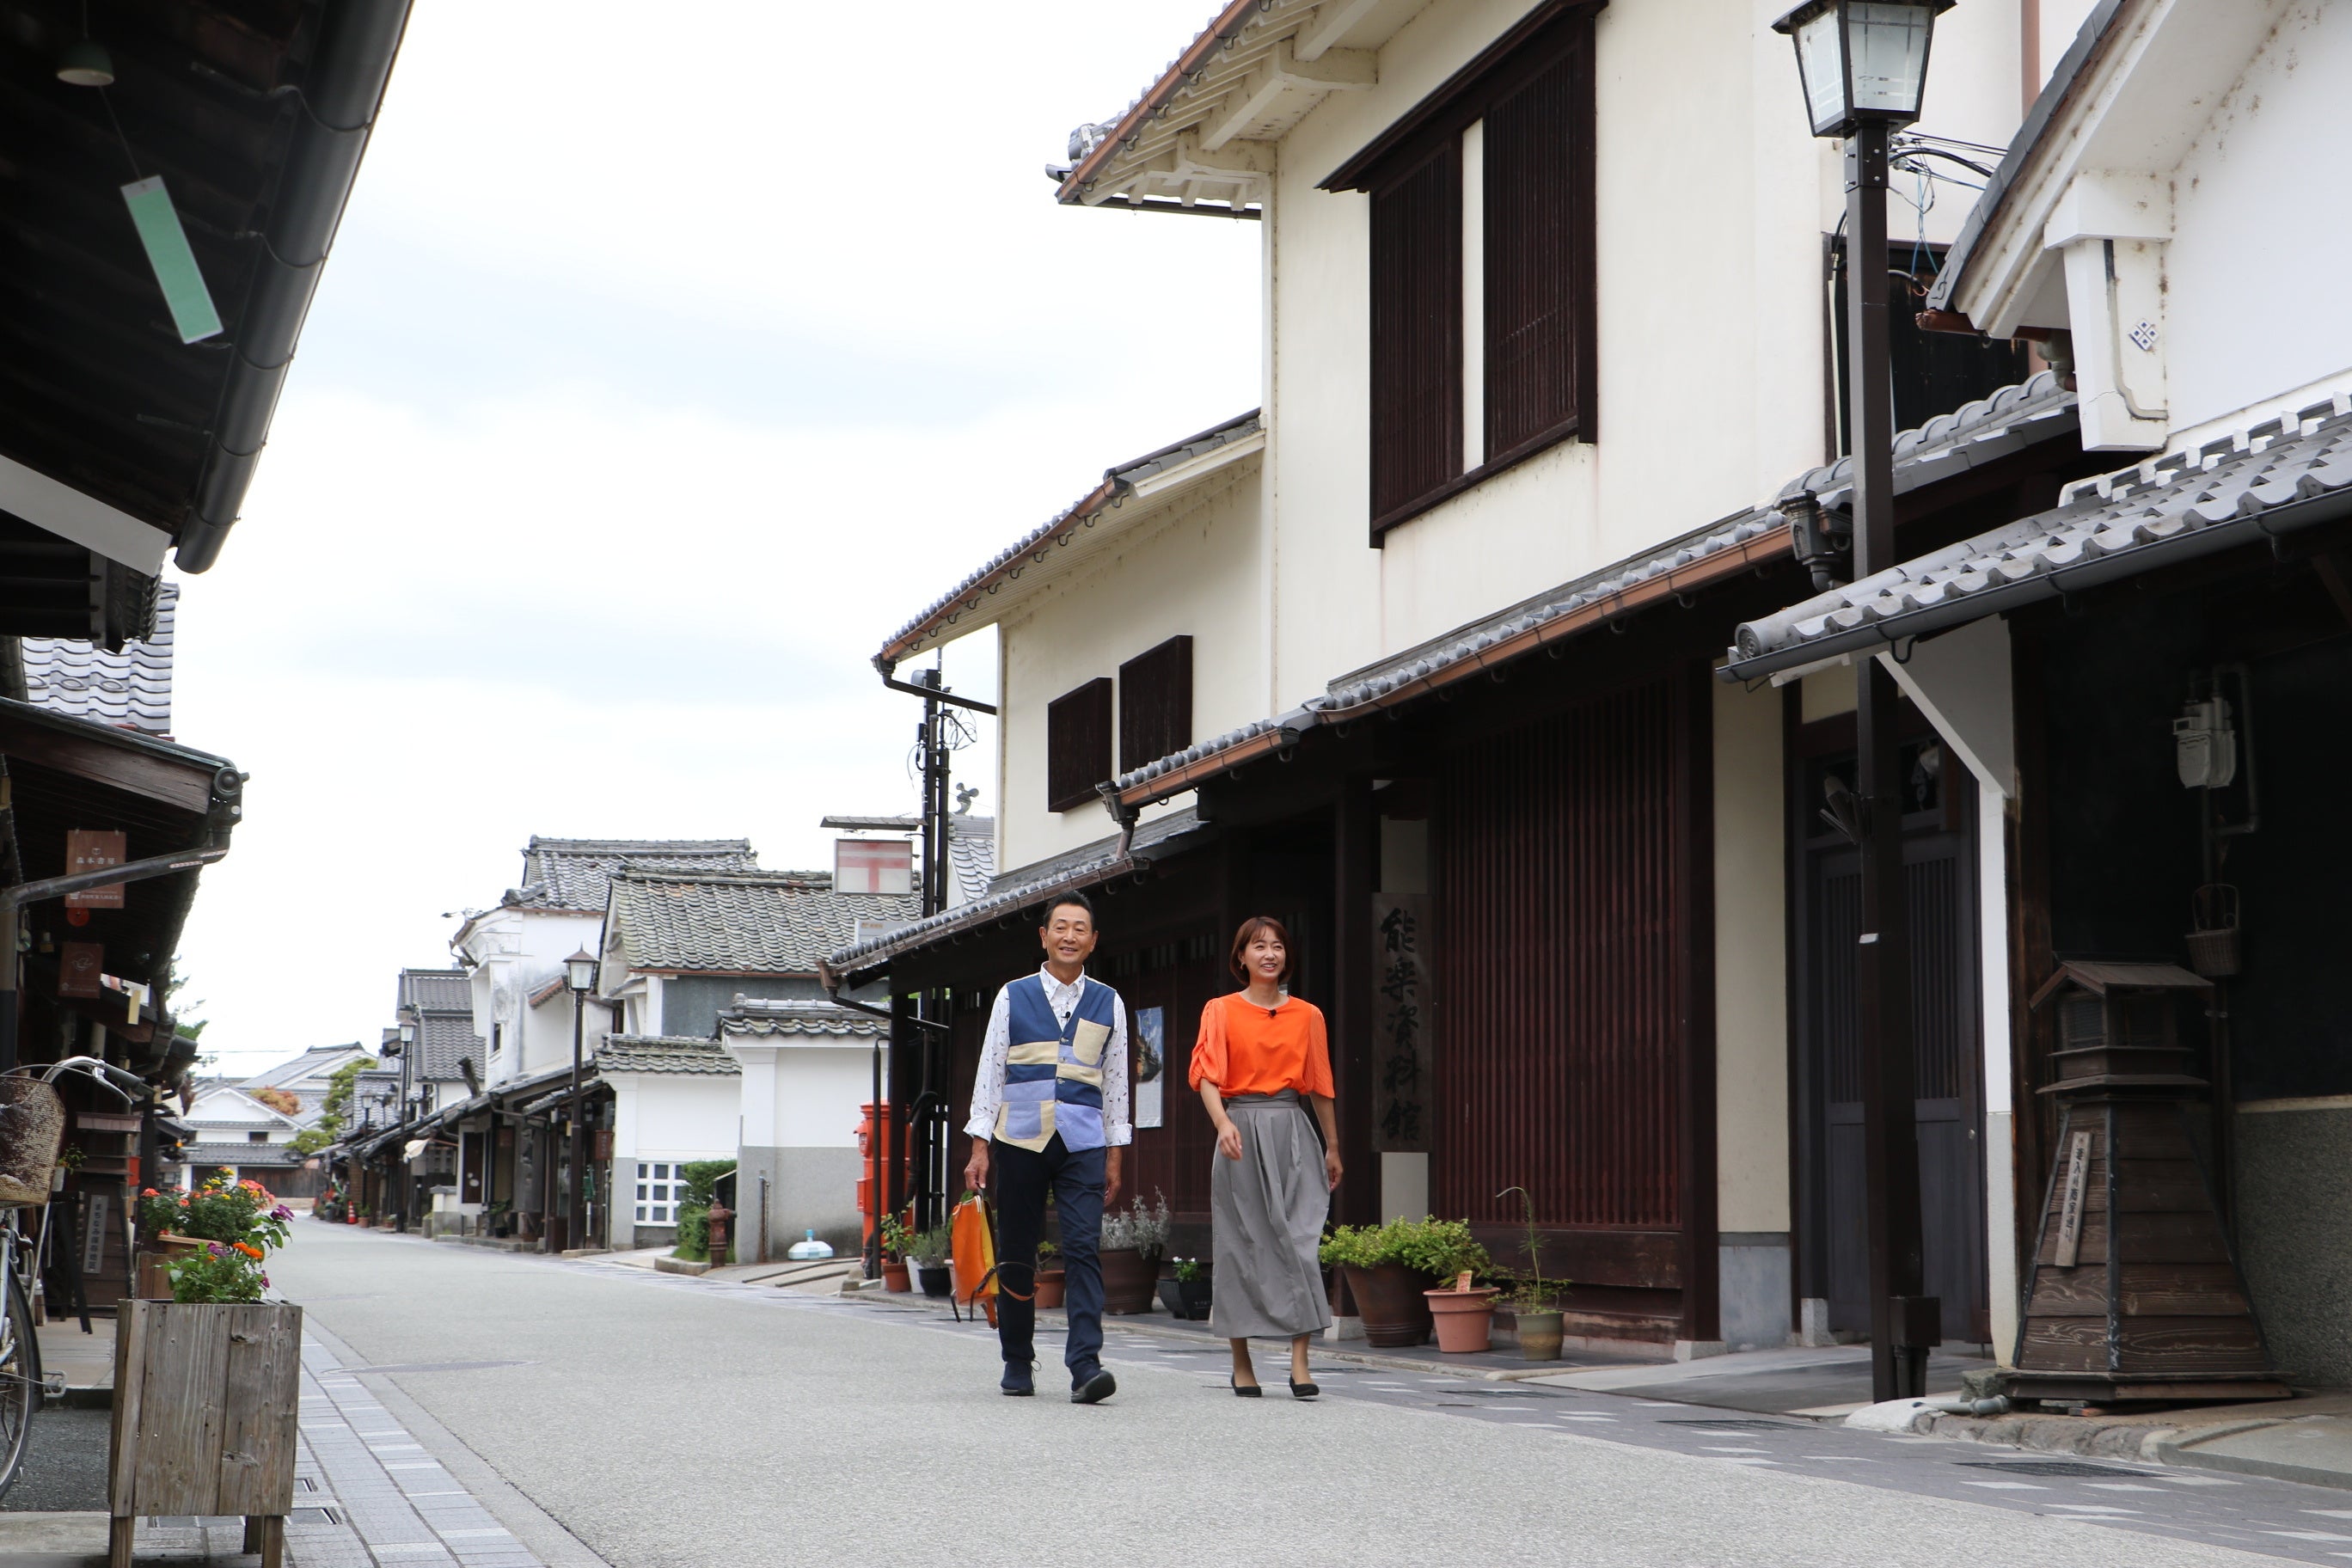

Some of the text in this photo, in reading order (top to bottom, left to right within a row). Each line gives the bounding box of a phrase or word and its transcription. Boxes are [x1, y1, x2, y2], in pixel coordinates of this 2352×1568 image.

[1380, 907, 1423, 1142] 能楽資料館
